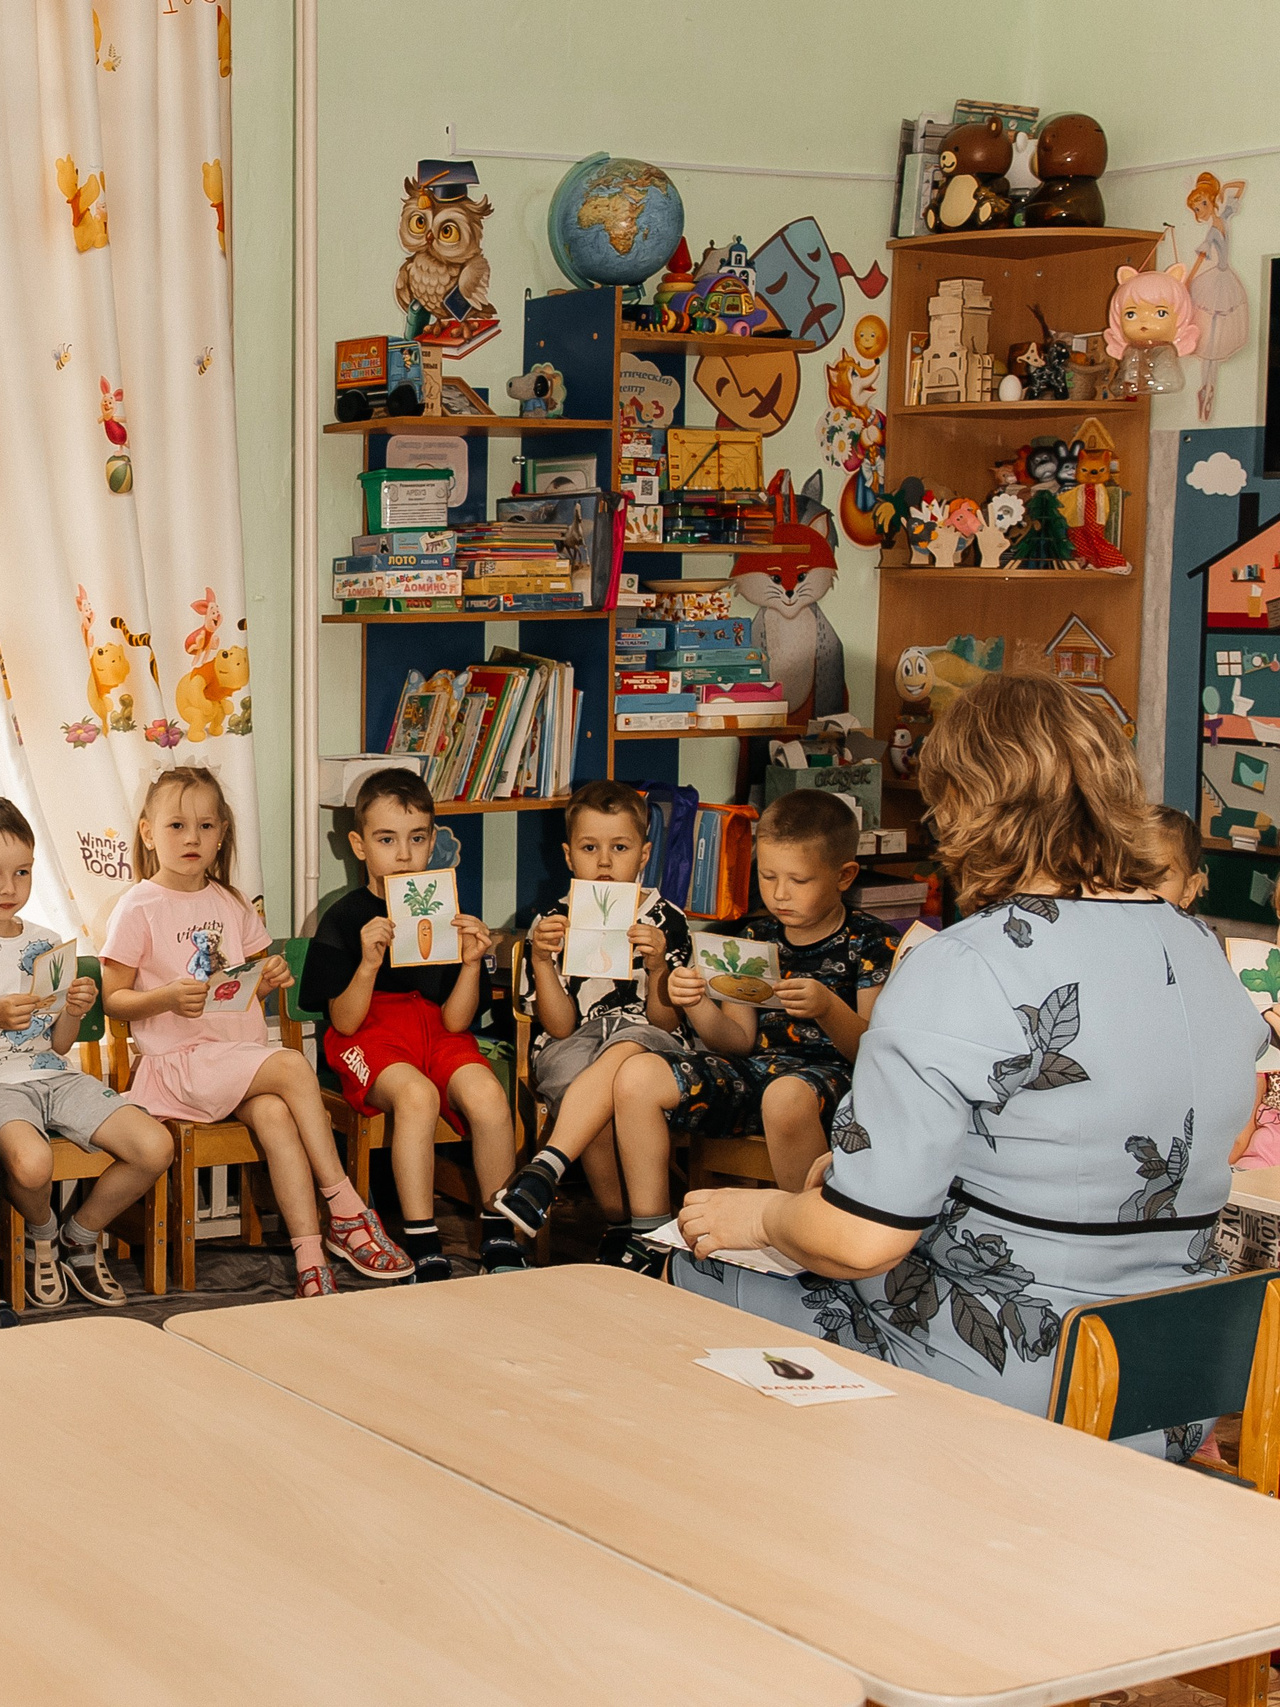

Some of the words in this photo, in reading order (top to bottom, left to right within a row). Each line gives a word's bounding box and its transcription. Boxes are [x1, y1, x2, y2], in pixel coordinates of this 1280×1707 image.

[388, 555, 417, 566] ЛОТО
[403, 582, 447, 593] ДОМИНО
[76, 830, 129, 854] Winnie
[94, 848, 115, 862] the
[79, 847, 133, 880] Pooh
